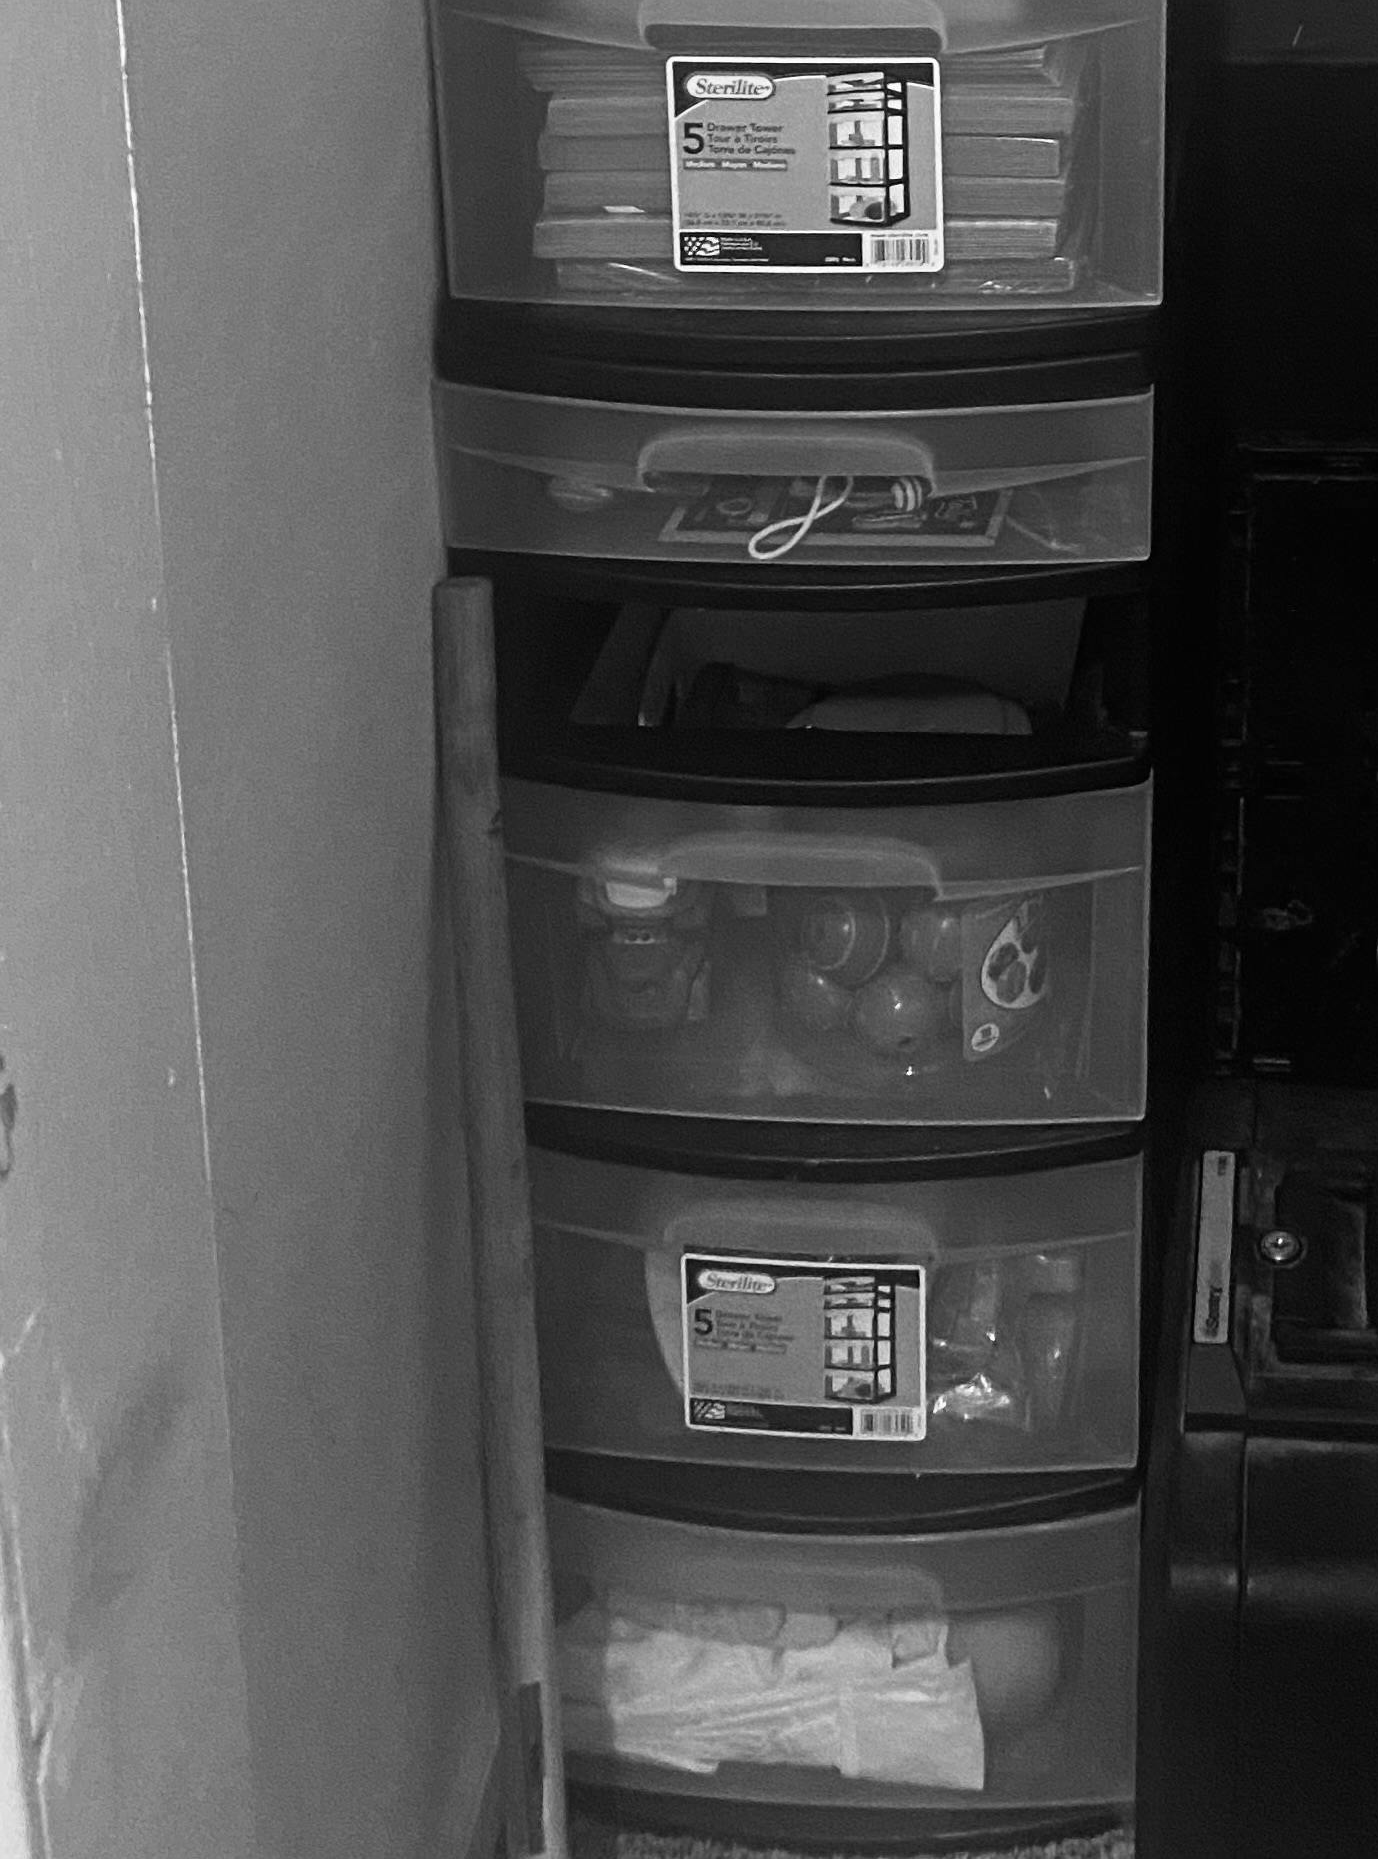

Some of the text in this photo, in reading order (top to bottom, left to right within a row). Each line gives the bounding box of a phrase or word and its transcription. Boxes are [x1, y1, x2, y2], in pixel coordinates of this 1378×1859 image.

[695, 77, 767, 96] Sterilite
[683, 122, 705, 155] 5
[707, 122, 783, 133] Drawer Tower
[694, 1308, 713, 1336] 5
